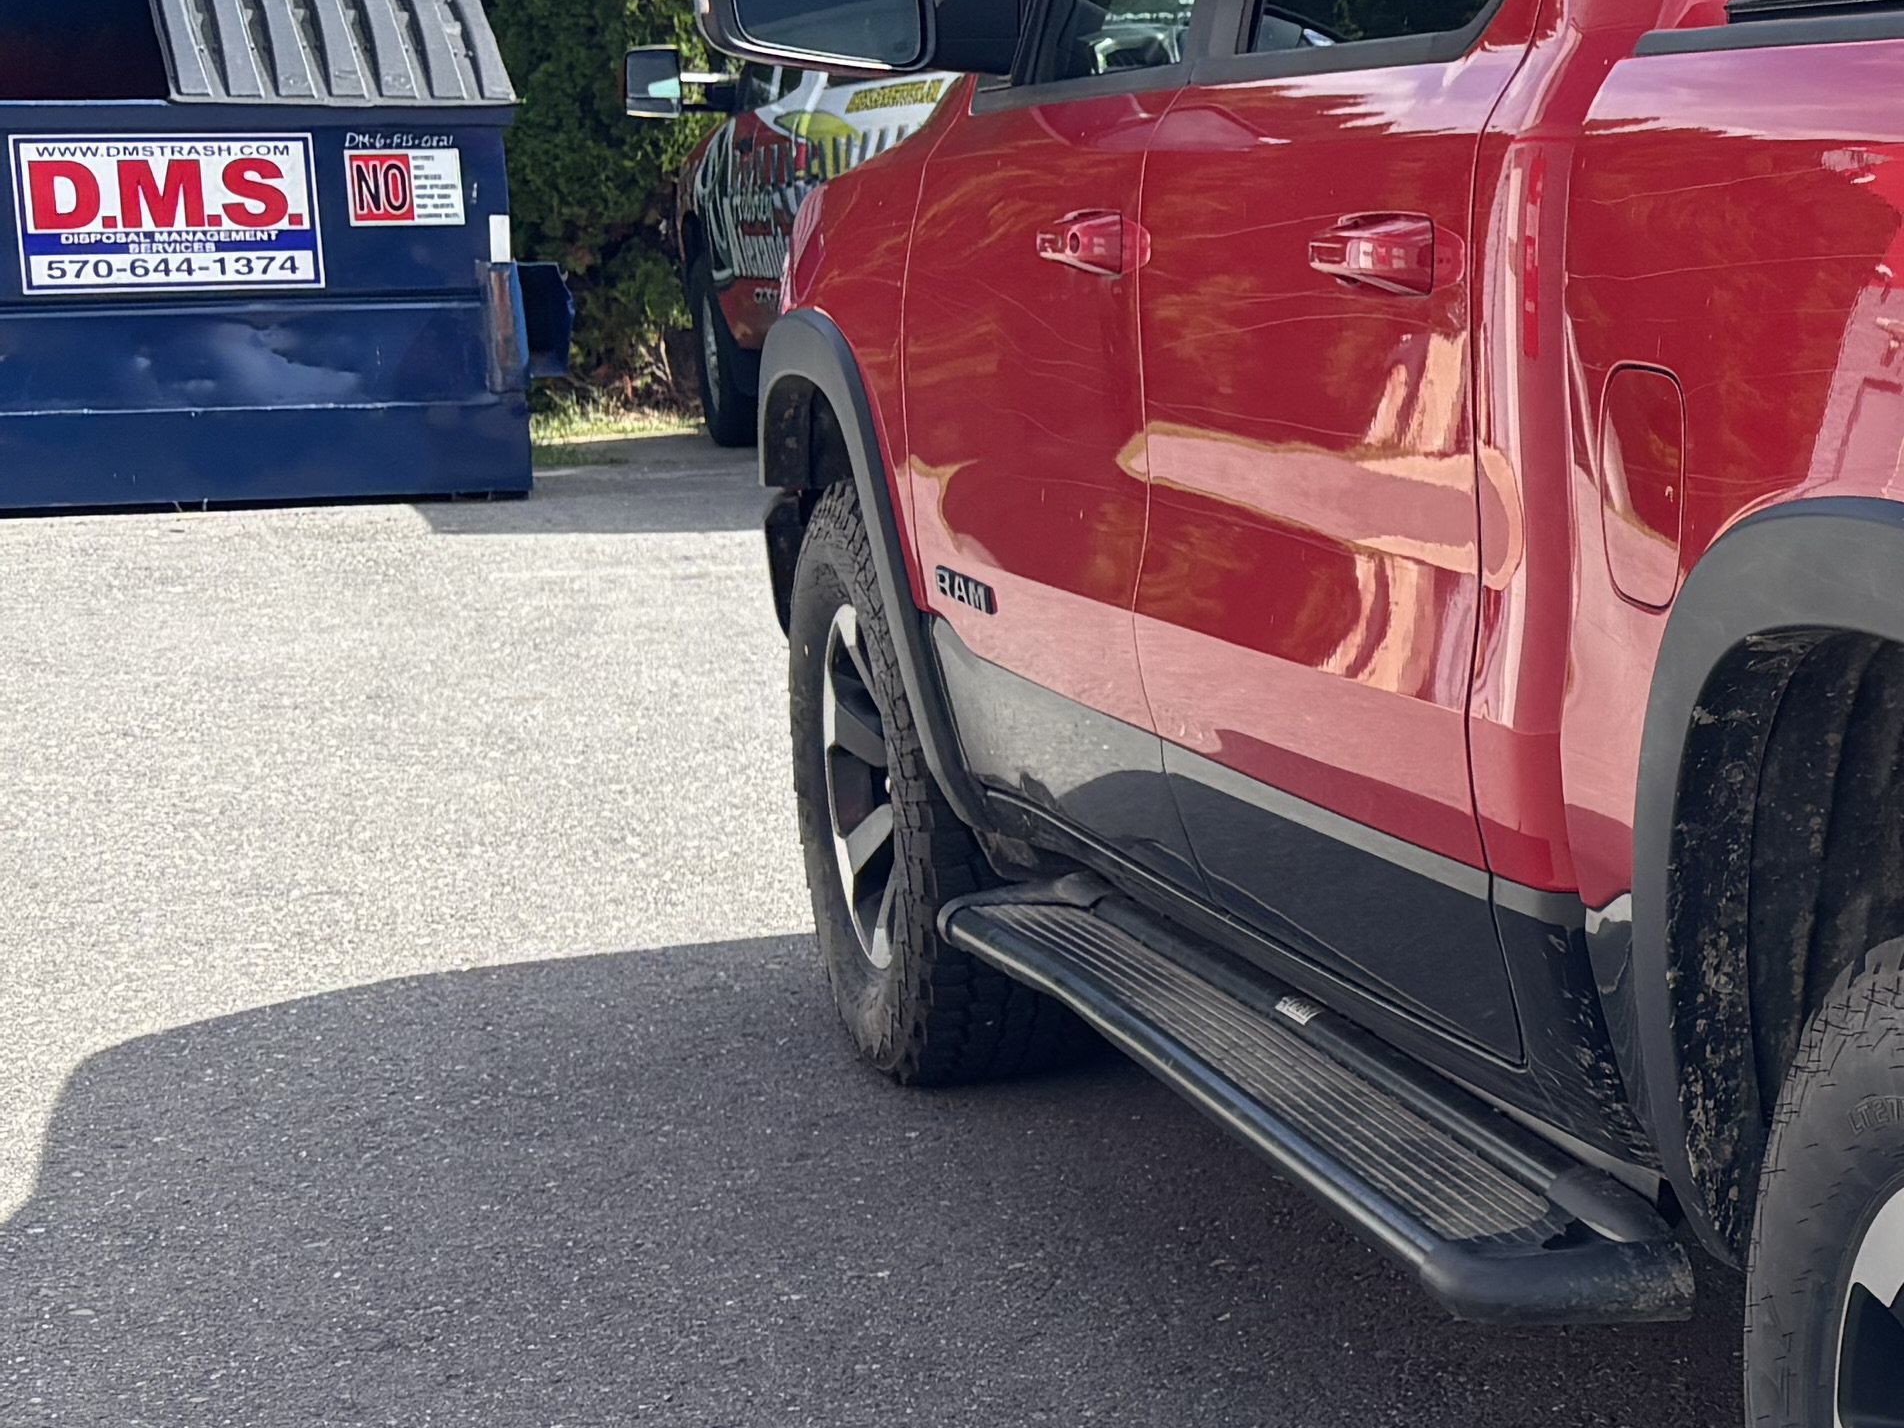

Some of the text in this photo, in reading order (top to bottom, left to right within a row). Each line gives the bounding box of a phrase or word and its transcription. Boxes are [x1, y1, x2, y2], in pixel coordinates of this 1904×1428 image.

[36, 144, 290, 158] WWW.DMSTRASH.COM
[28, 157, 304, 230] D.M.S.
[352, 160, 410, 215] NO
[60, 230, 279, 245] DISPOSAL MANAGEMENT
[128, 243, 217, 254] SERVICES
[46, 256, 300, 279] 570-644-1374
[936, 569, 986, 613] RAM
